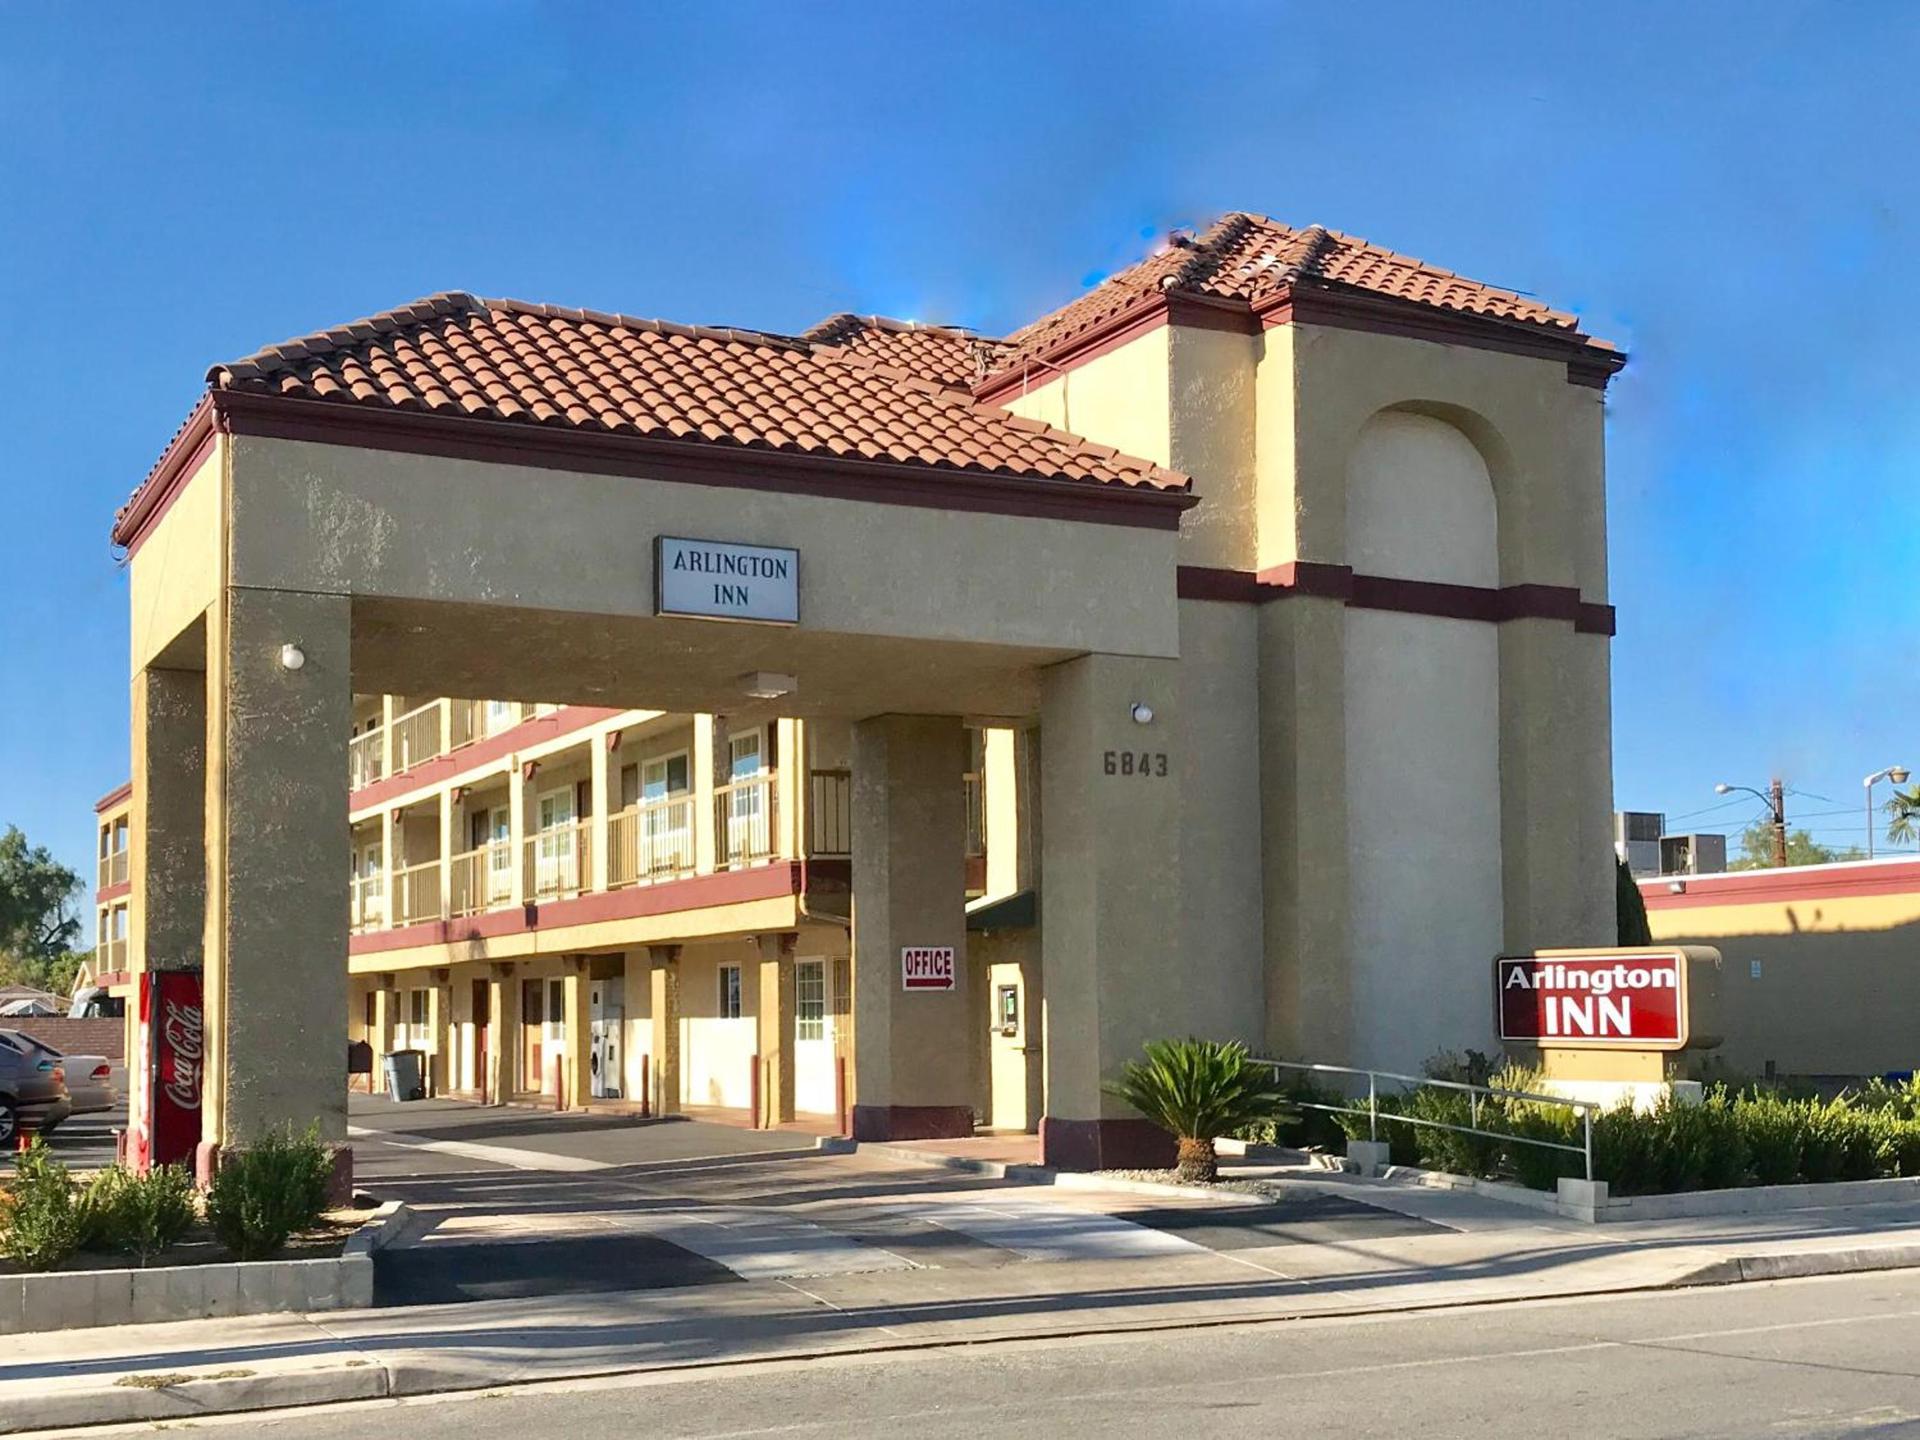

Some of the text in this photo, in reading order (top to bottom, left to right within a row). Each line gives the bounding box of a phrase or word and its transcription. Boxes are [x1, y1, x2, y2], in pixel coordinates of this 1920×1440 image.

[673, 550, 788, 579] ARLINGTON
[714, 584, 749, 606] INN
[1104, 751, 1168, 777] 6843
[905, 950, 951, 976] OFFICE
[1505, 964, 1676, 995] Arlington
[1545, 996, 1632, 1036] INN
